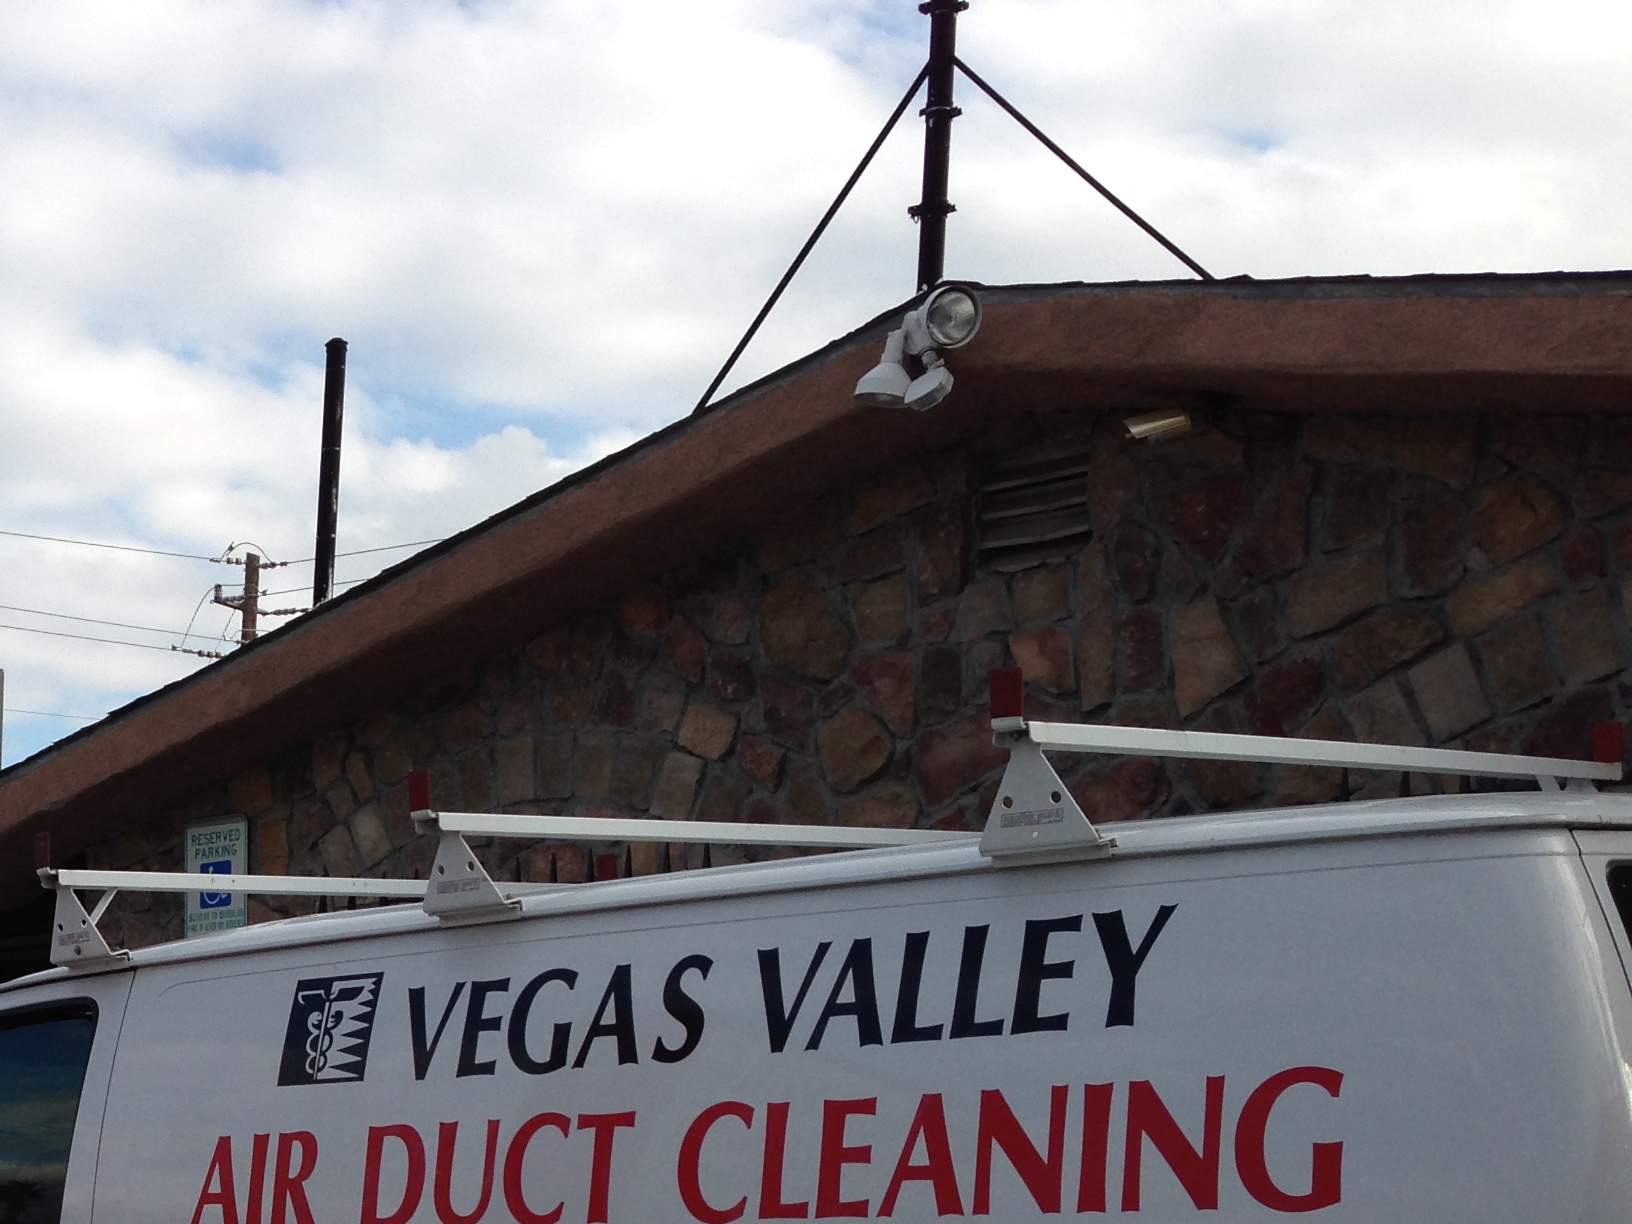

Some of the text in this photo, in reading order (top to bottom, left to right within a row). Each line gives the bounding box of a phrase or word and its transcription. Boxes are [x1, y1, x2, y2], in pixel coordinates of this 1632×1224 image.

[191, 828, 241, 847] RESERVED
[194, 843, 237, 860] PARKING
[407, 903, 1179, 1081] VEGAS VALLEY
